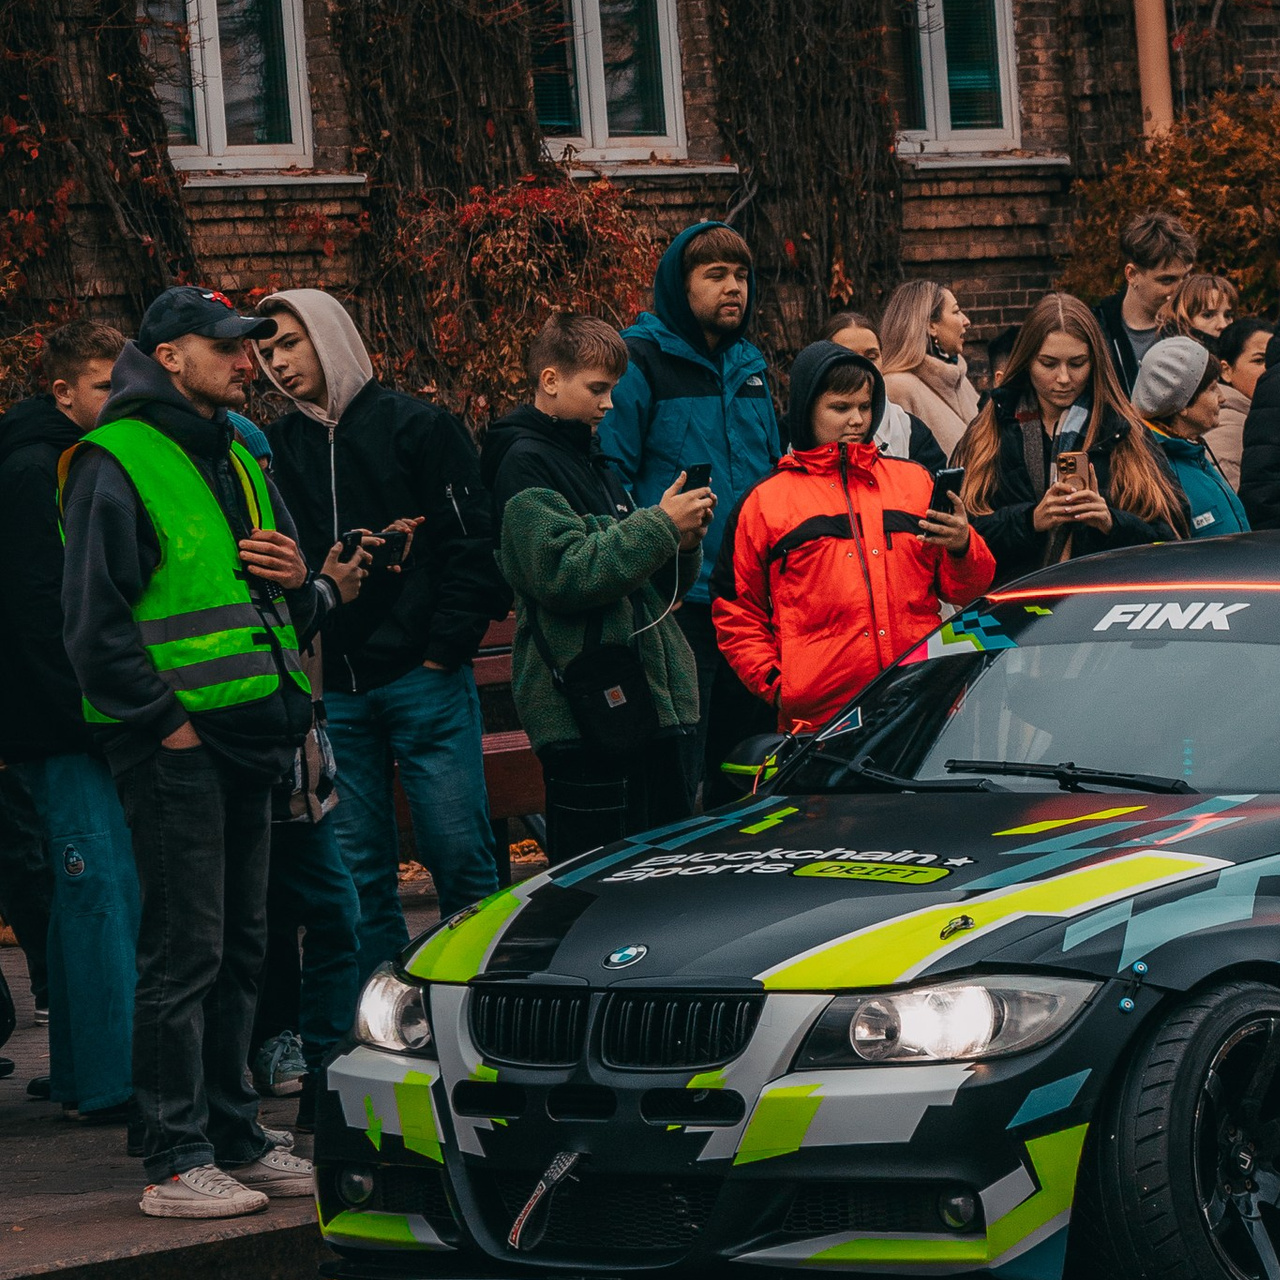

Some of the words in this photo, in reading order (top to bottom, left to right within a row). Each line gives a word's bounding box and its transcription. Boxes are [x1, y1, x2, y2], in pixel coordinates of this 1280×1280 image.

[1093, 602, 1250, 631] FINK
[631, 847, 938, 868] Blockchain
[602, 861, 795, 882] Sports
[817, 864, 929, 880] DRIFT
